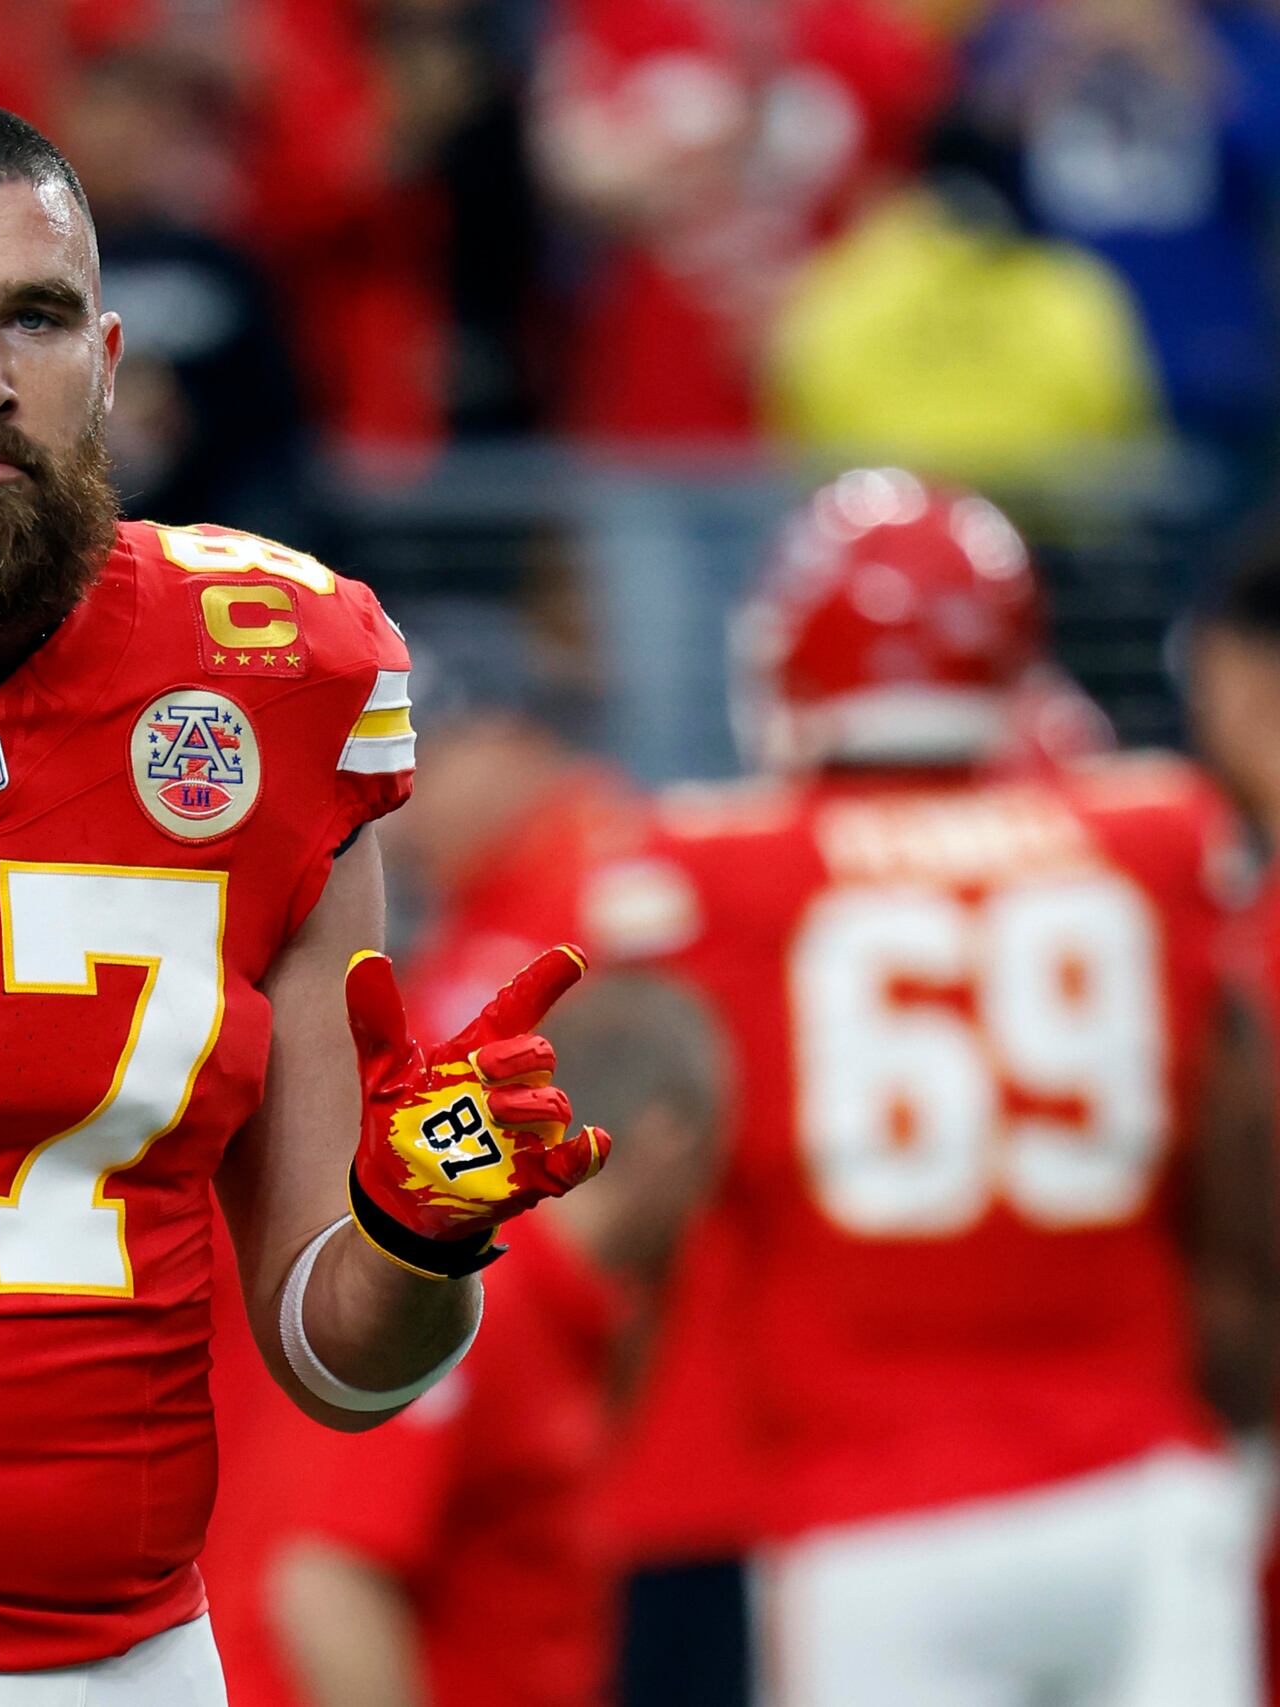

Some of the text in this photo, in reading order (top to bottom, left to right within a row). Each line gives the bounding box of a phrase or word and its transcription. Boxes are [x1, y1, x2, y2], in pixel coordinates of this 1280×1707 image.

[200, 585, 298, 649] C
[148, 705, 244, 784] A
[181, 786, 211, 807] LH
[789, 875, 1167, 1238] 69
[421, 1093, 503, 1182] 87
